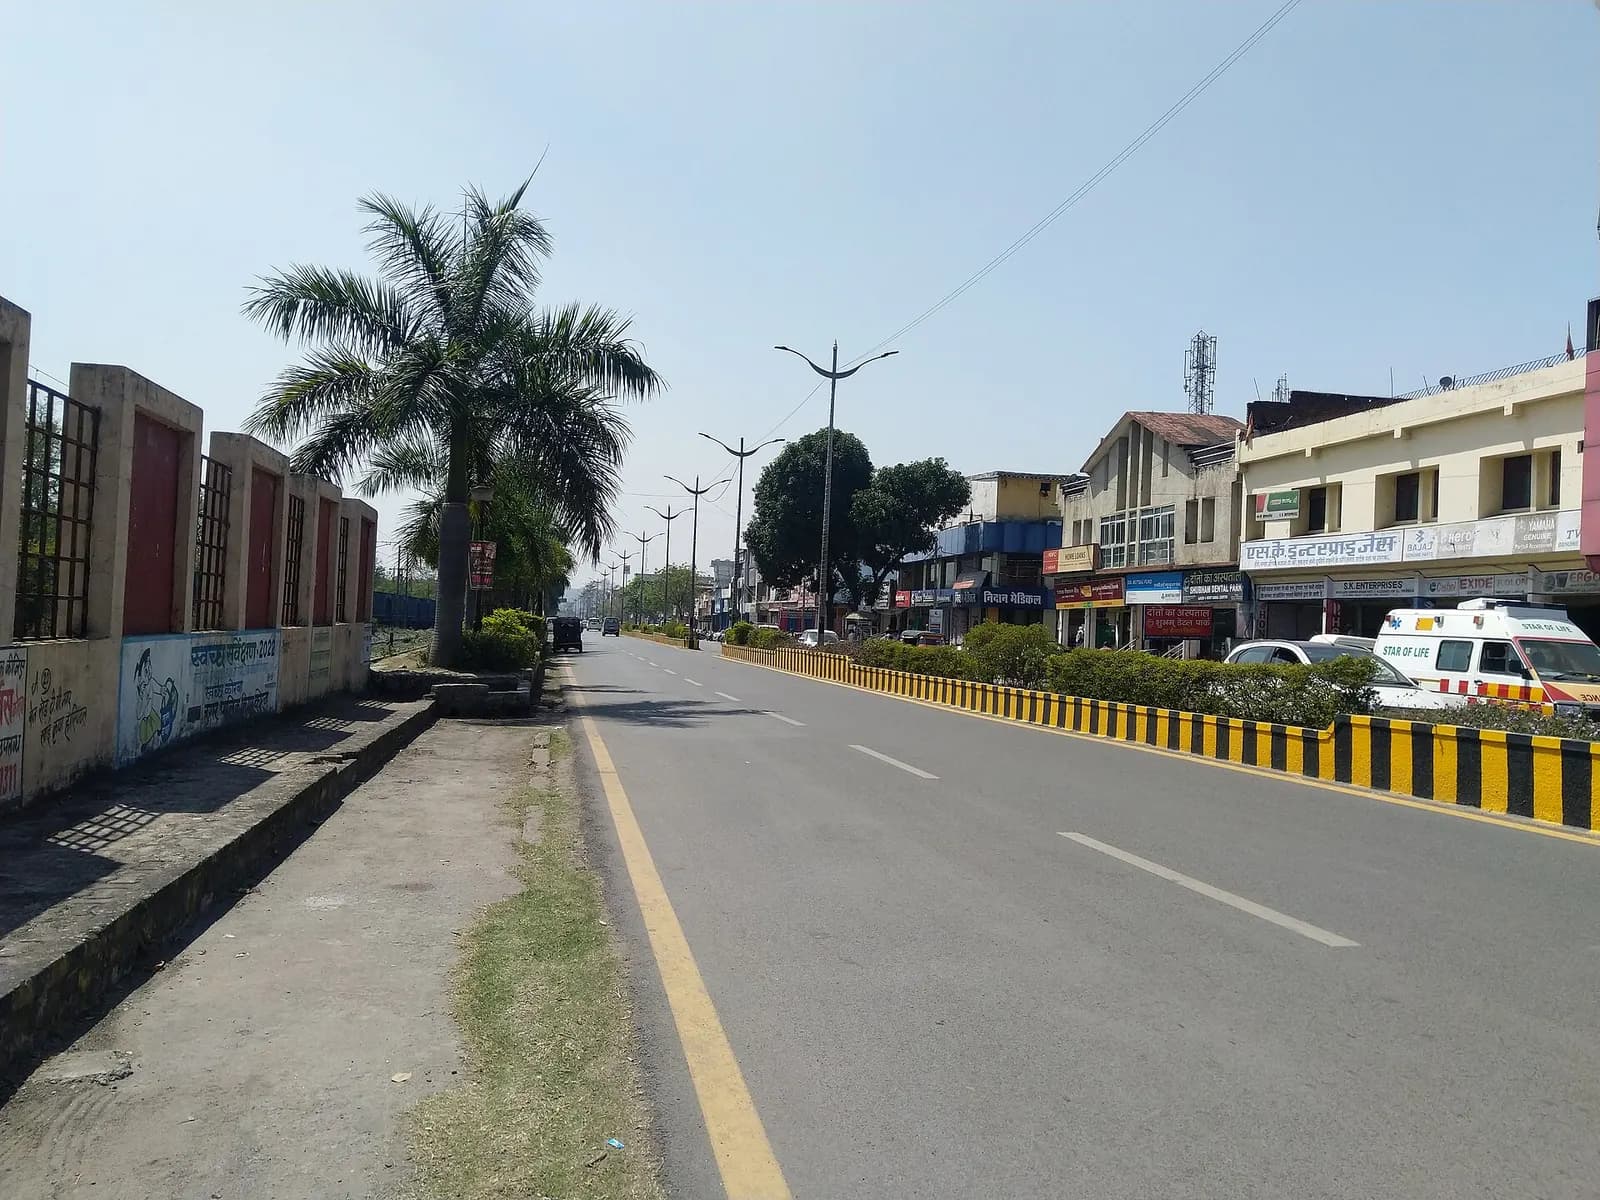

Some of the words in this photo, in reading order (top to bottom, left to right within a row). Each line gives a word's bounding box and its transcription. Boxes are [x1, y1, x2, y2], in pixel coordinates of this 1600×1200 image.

[1528, 518, 1555, 531] YAMAHA
[1407, 540, 1433, 551] BAJAJ
[1211, 584, 1229, 593] DENTAL
[1229, 583, 1243, 593] PARK
[1459, 577, 1493, 590] EXIDE
[983, 590, 1008, 603] निदान
[1009, 591, 1042, 605] मेडिकल
[1176, 608, 1210, 617] अस्पताल
[1383, 645, 1401, 656] STAR
[1402, 646, 1413, 657] OF
[1413, 647, 1430, 658] LIFE
